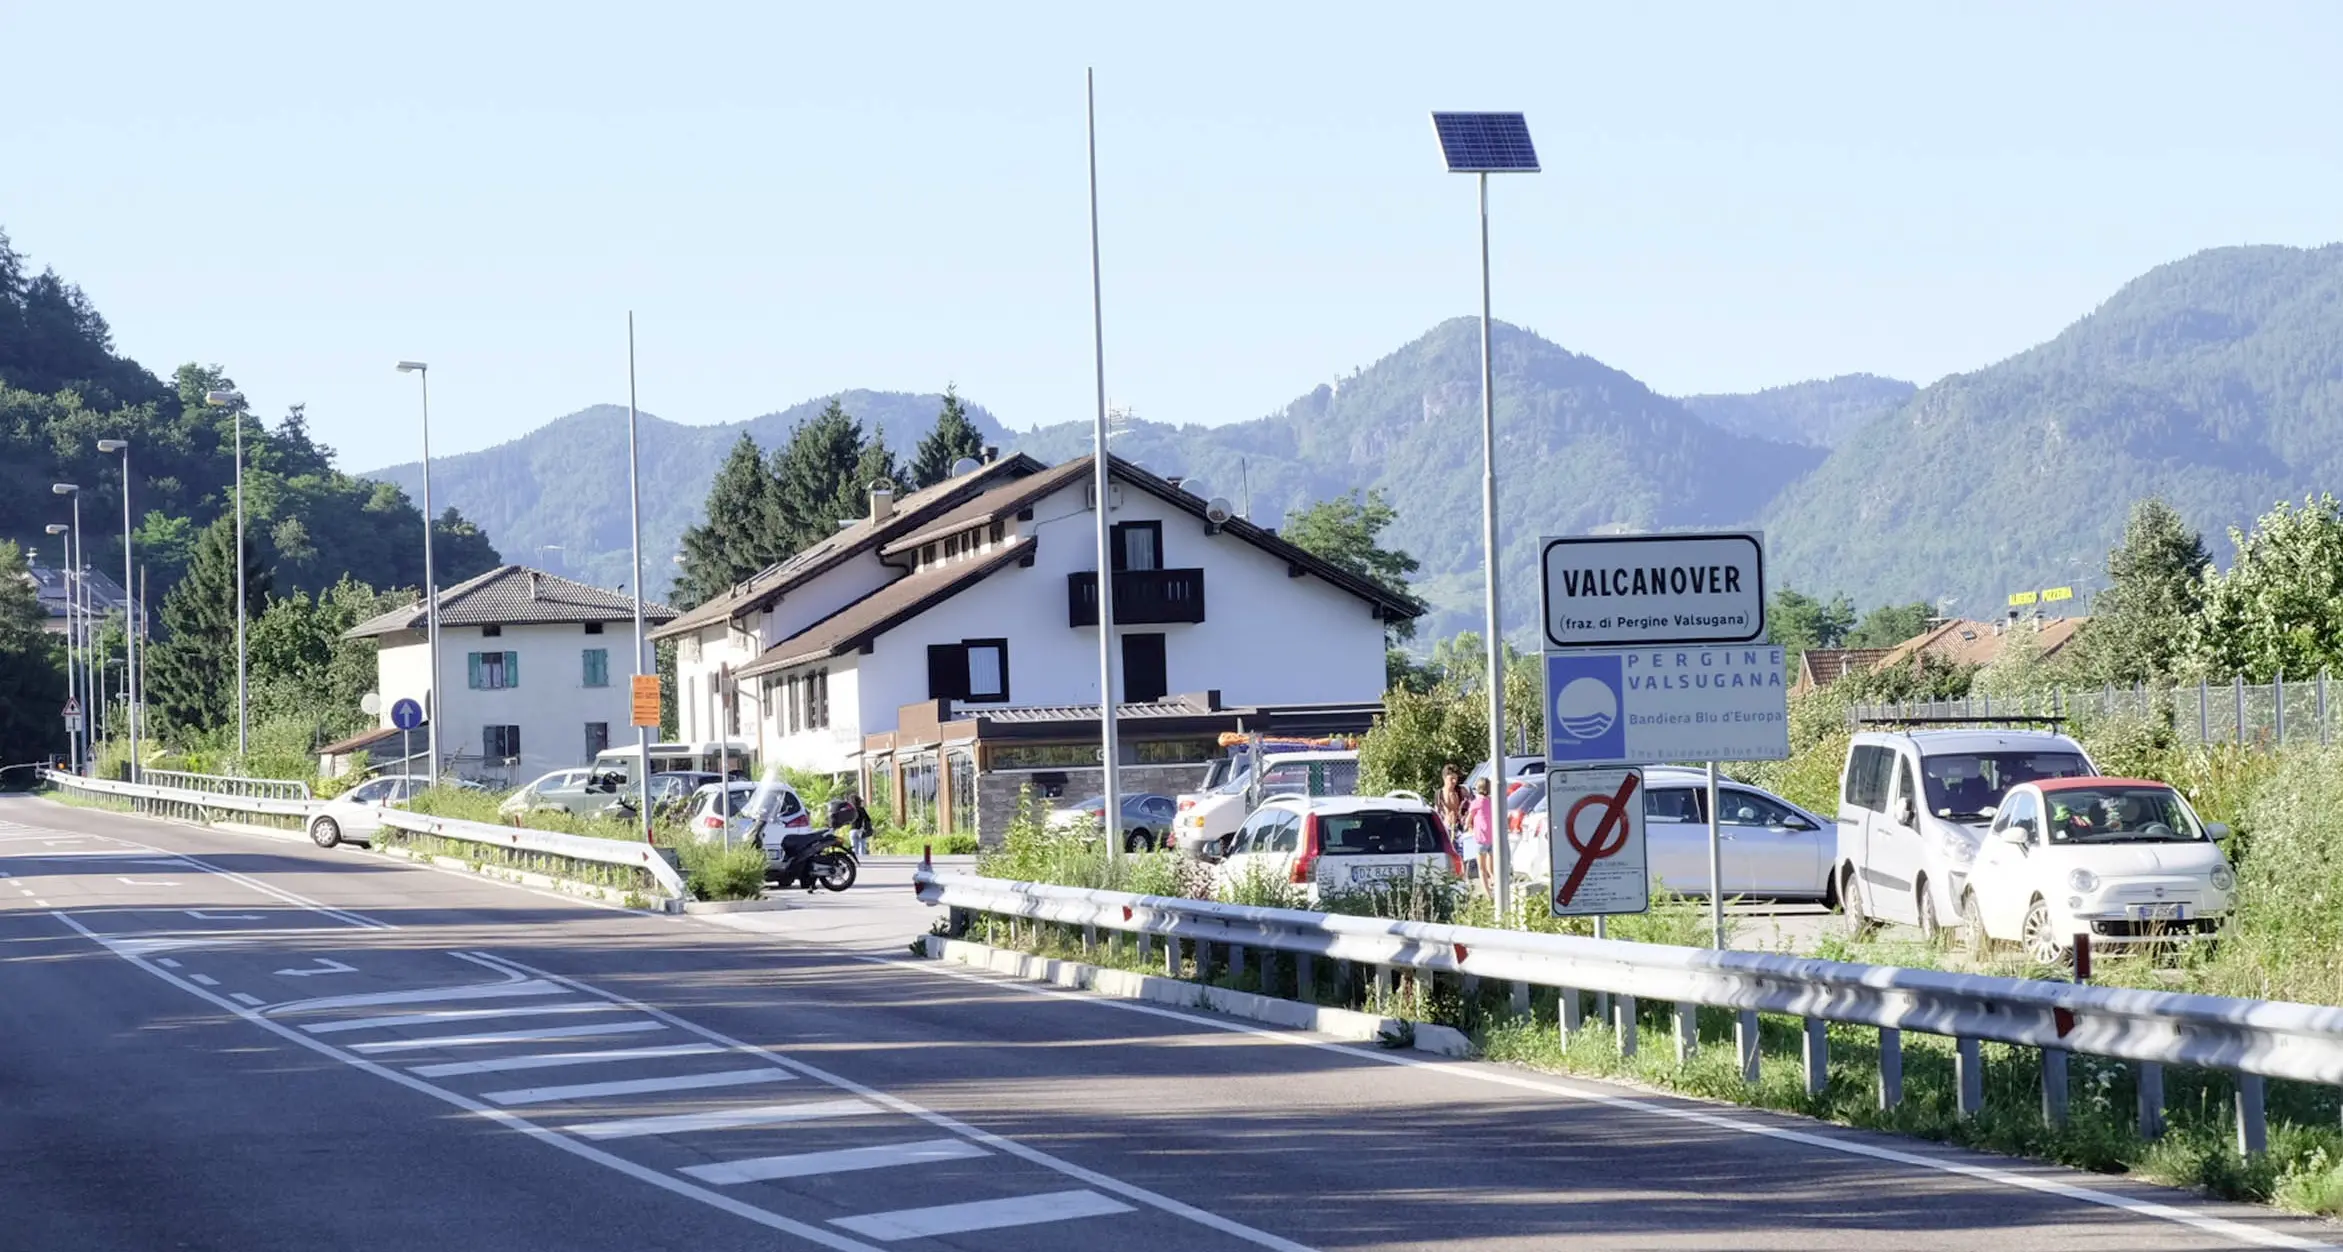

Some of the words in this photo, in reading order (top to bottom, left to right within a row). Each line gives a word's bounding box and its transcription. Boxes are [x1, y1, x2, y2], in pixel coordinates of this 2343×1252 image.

[1562, 565, 1741, 598] VALCANOVER
[1560, 614, 1596, 634] (fraz.
[1599, 617, 1612, 629] di
[1617, 614, 1669, 630] Pergine
[1674, 610, 1750, 629] Valsugana)
[1627, 650, 1781, 668] PERGINE
[1628, 672, 1781, 690] VALSUGANA
[1629, 712, 1692, 725] Bandiera
[1695, 711, 1718, 723] Blu
[1722, 711, 1783, 724] d'Europa
